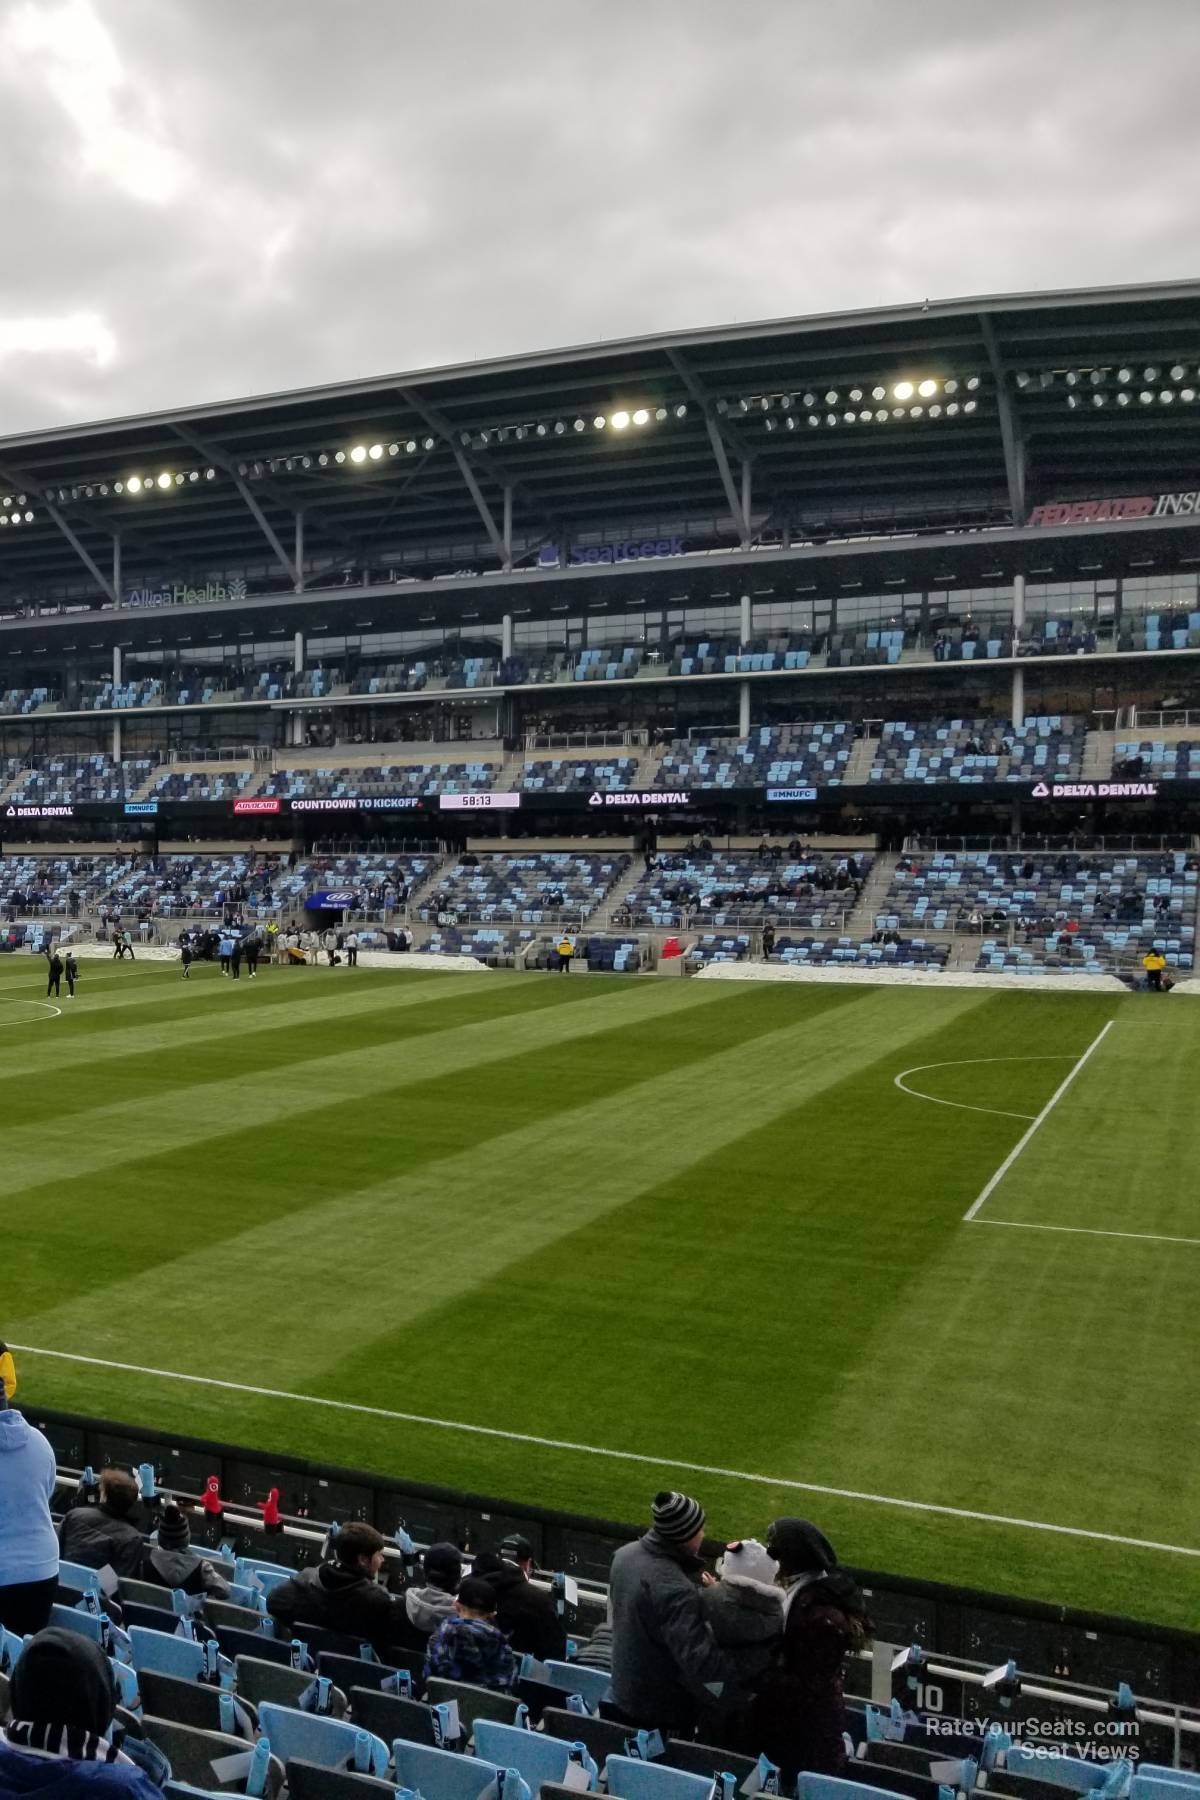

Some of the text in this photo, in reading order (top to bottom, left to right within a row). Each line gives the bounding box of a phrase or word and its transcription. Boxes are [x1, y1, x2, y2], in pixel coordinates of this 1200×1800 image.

[1028, 497, 1153, 524] FEDERATED
[571, 538, 684, 563] SeatGeek
[772, 789, 811, 799] #MNUFC
[1052, 783, 1157, 797] DELTA DENTAL
[291, 798, 419, 810] COUNTDOWN TO KICKOFF
[462, 796, 491, 806] 58:13
[605, 791, 689, 805] DELTA DENTAL
[17, 807, 73, 816] DELTA DENTAL
[915, 1684, 943, 1711] 10
